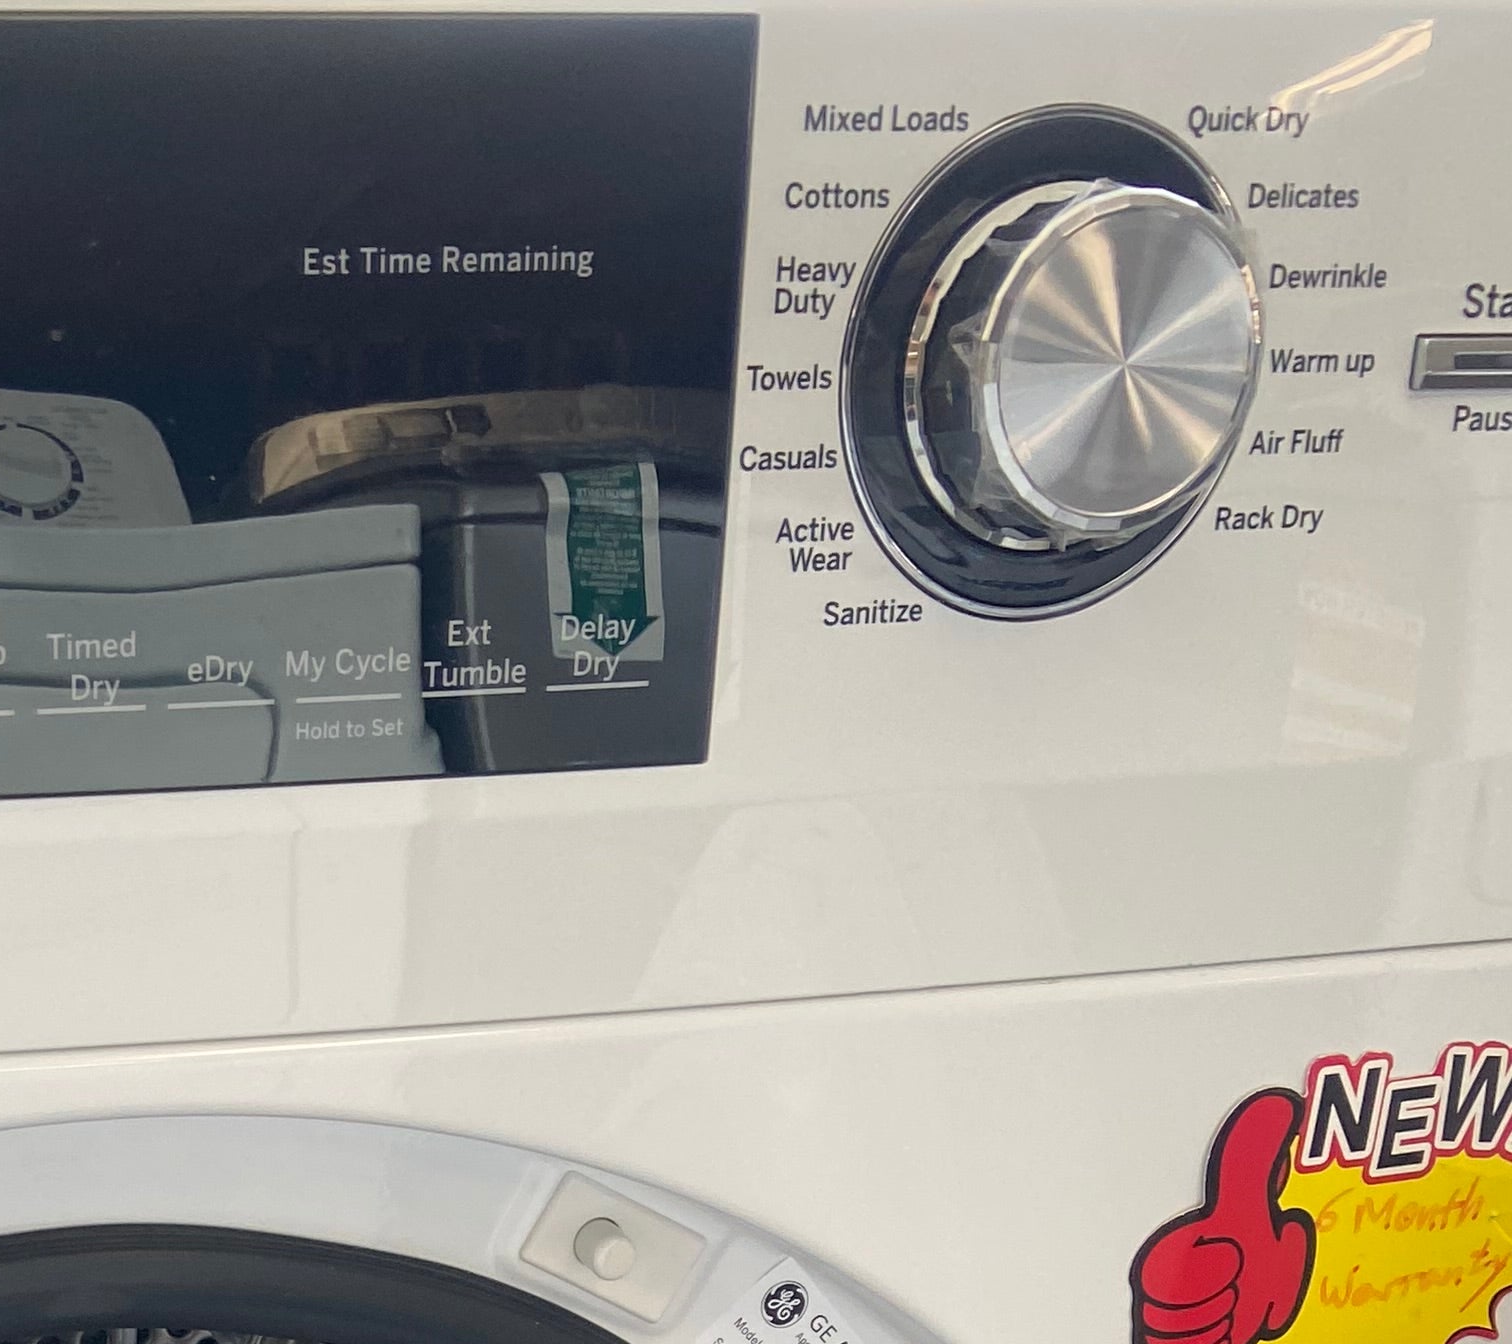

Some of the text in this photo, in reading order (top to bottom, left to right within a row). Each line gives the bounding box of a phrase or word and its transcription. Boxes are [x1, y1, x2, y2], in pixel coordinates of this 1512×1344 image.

[804, 105, 969, 132] Mixed Loads
[1188, 107, 1310, 138] Quick Dry
[785, 183, 890, 209] Cottons
[1248, 184, 1360, 208] Delicates
[303, 245, 595, 277] Est Time Remaining
[776, 256, 856, 288] Heavy
[1269, 264, 1388, 289] Dewrinkle
[774, 289, 835, 319] Duty
[1269, 350, 1375, 379] Warm up
[746, 366, 832, 392] Towels
[1249, 430, 1345, 455] Air Fluff
[739, 445, 838, 471] Casuals
[776, 518, 855, 544] Active
[1215, 506, 1325, 533] Rack Dry
[789, 547, 851, 573] Wear
[823, 601, 923, 626] Sanitize
[447, 619, 491, 647] Ext
[561, 614, 636, 645] Delay
[47, 631, 136, 660] Timed
[188, 655, 253, 687] eDry
[286, 646, 411, 679] My Cycle
[424, 659, 527, 688] Tumble
[573, 651, 621, 681] Dry
[70, 674, 120, 706] Dry
[295, 718, 404, 741] Hold to Set
[807, 1311, 837, 1343] GE
